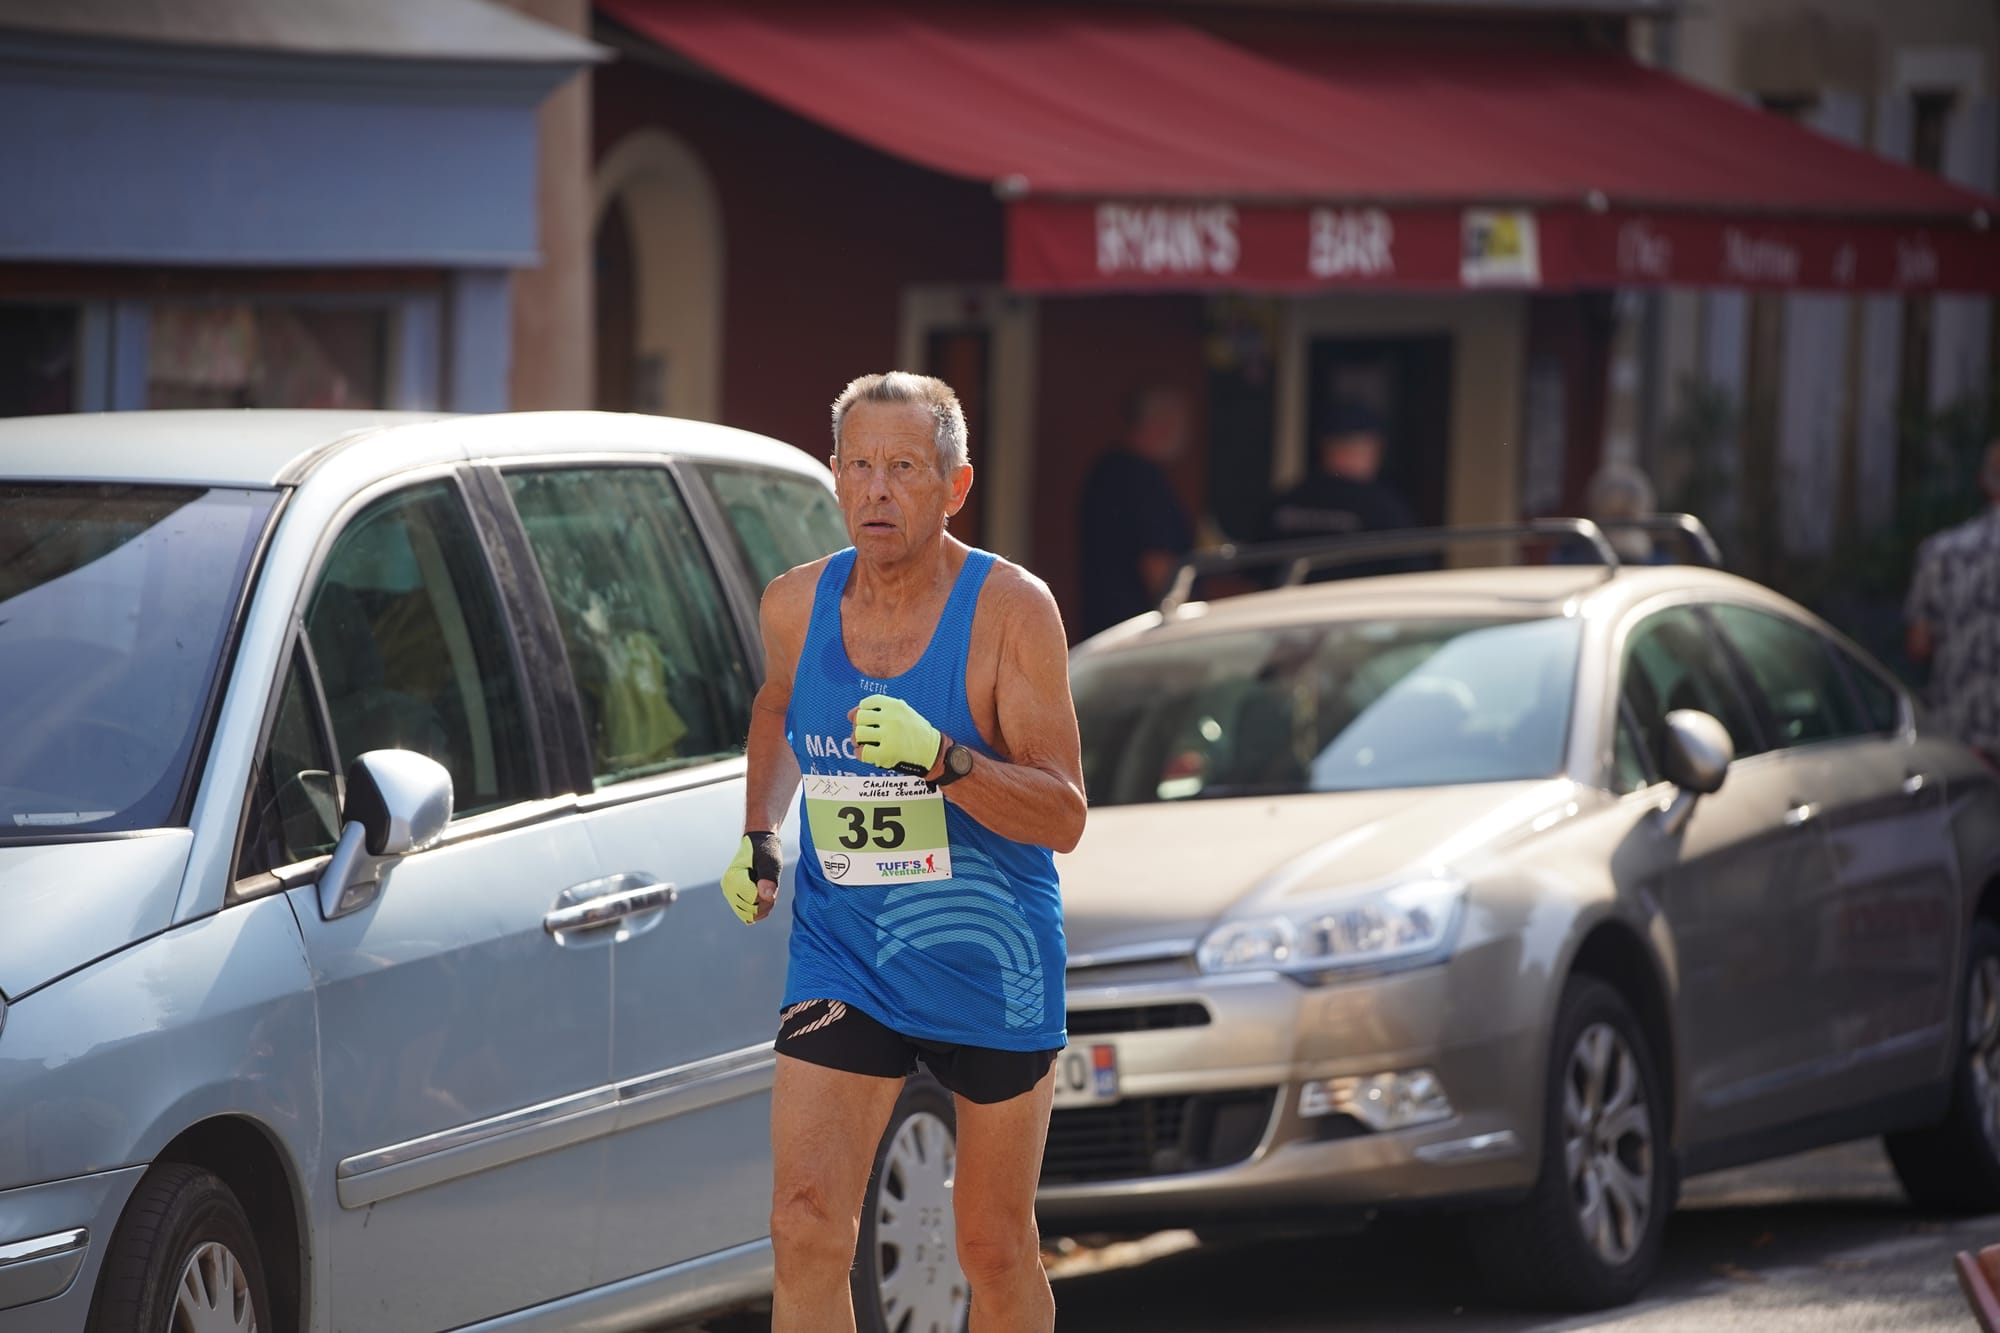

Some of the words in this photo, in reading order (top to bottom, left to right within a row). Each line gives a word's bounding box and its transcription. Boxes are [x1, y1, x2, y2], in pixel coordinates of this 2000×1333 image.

[1096, 203, 1240, 275] RYAN'S
[1308, 206, 1395, 277] BAR
[863, 780, 908, 790] Challenge
[837, 806, 905, 849] 35
[876, 860, 921, 871] TUFF'S
[881, 867, 927, 877] Aventure
